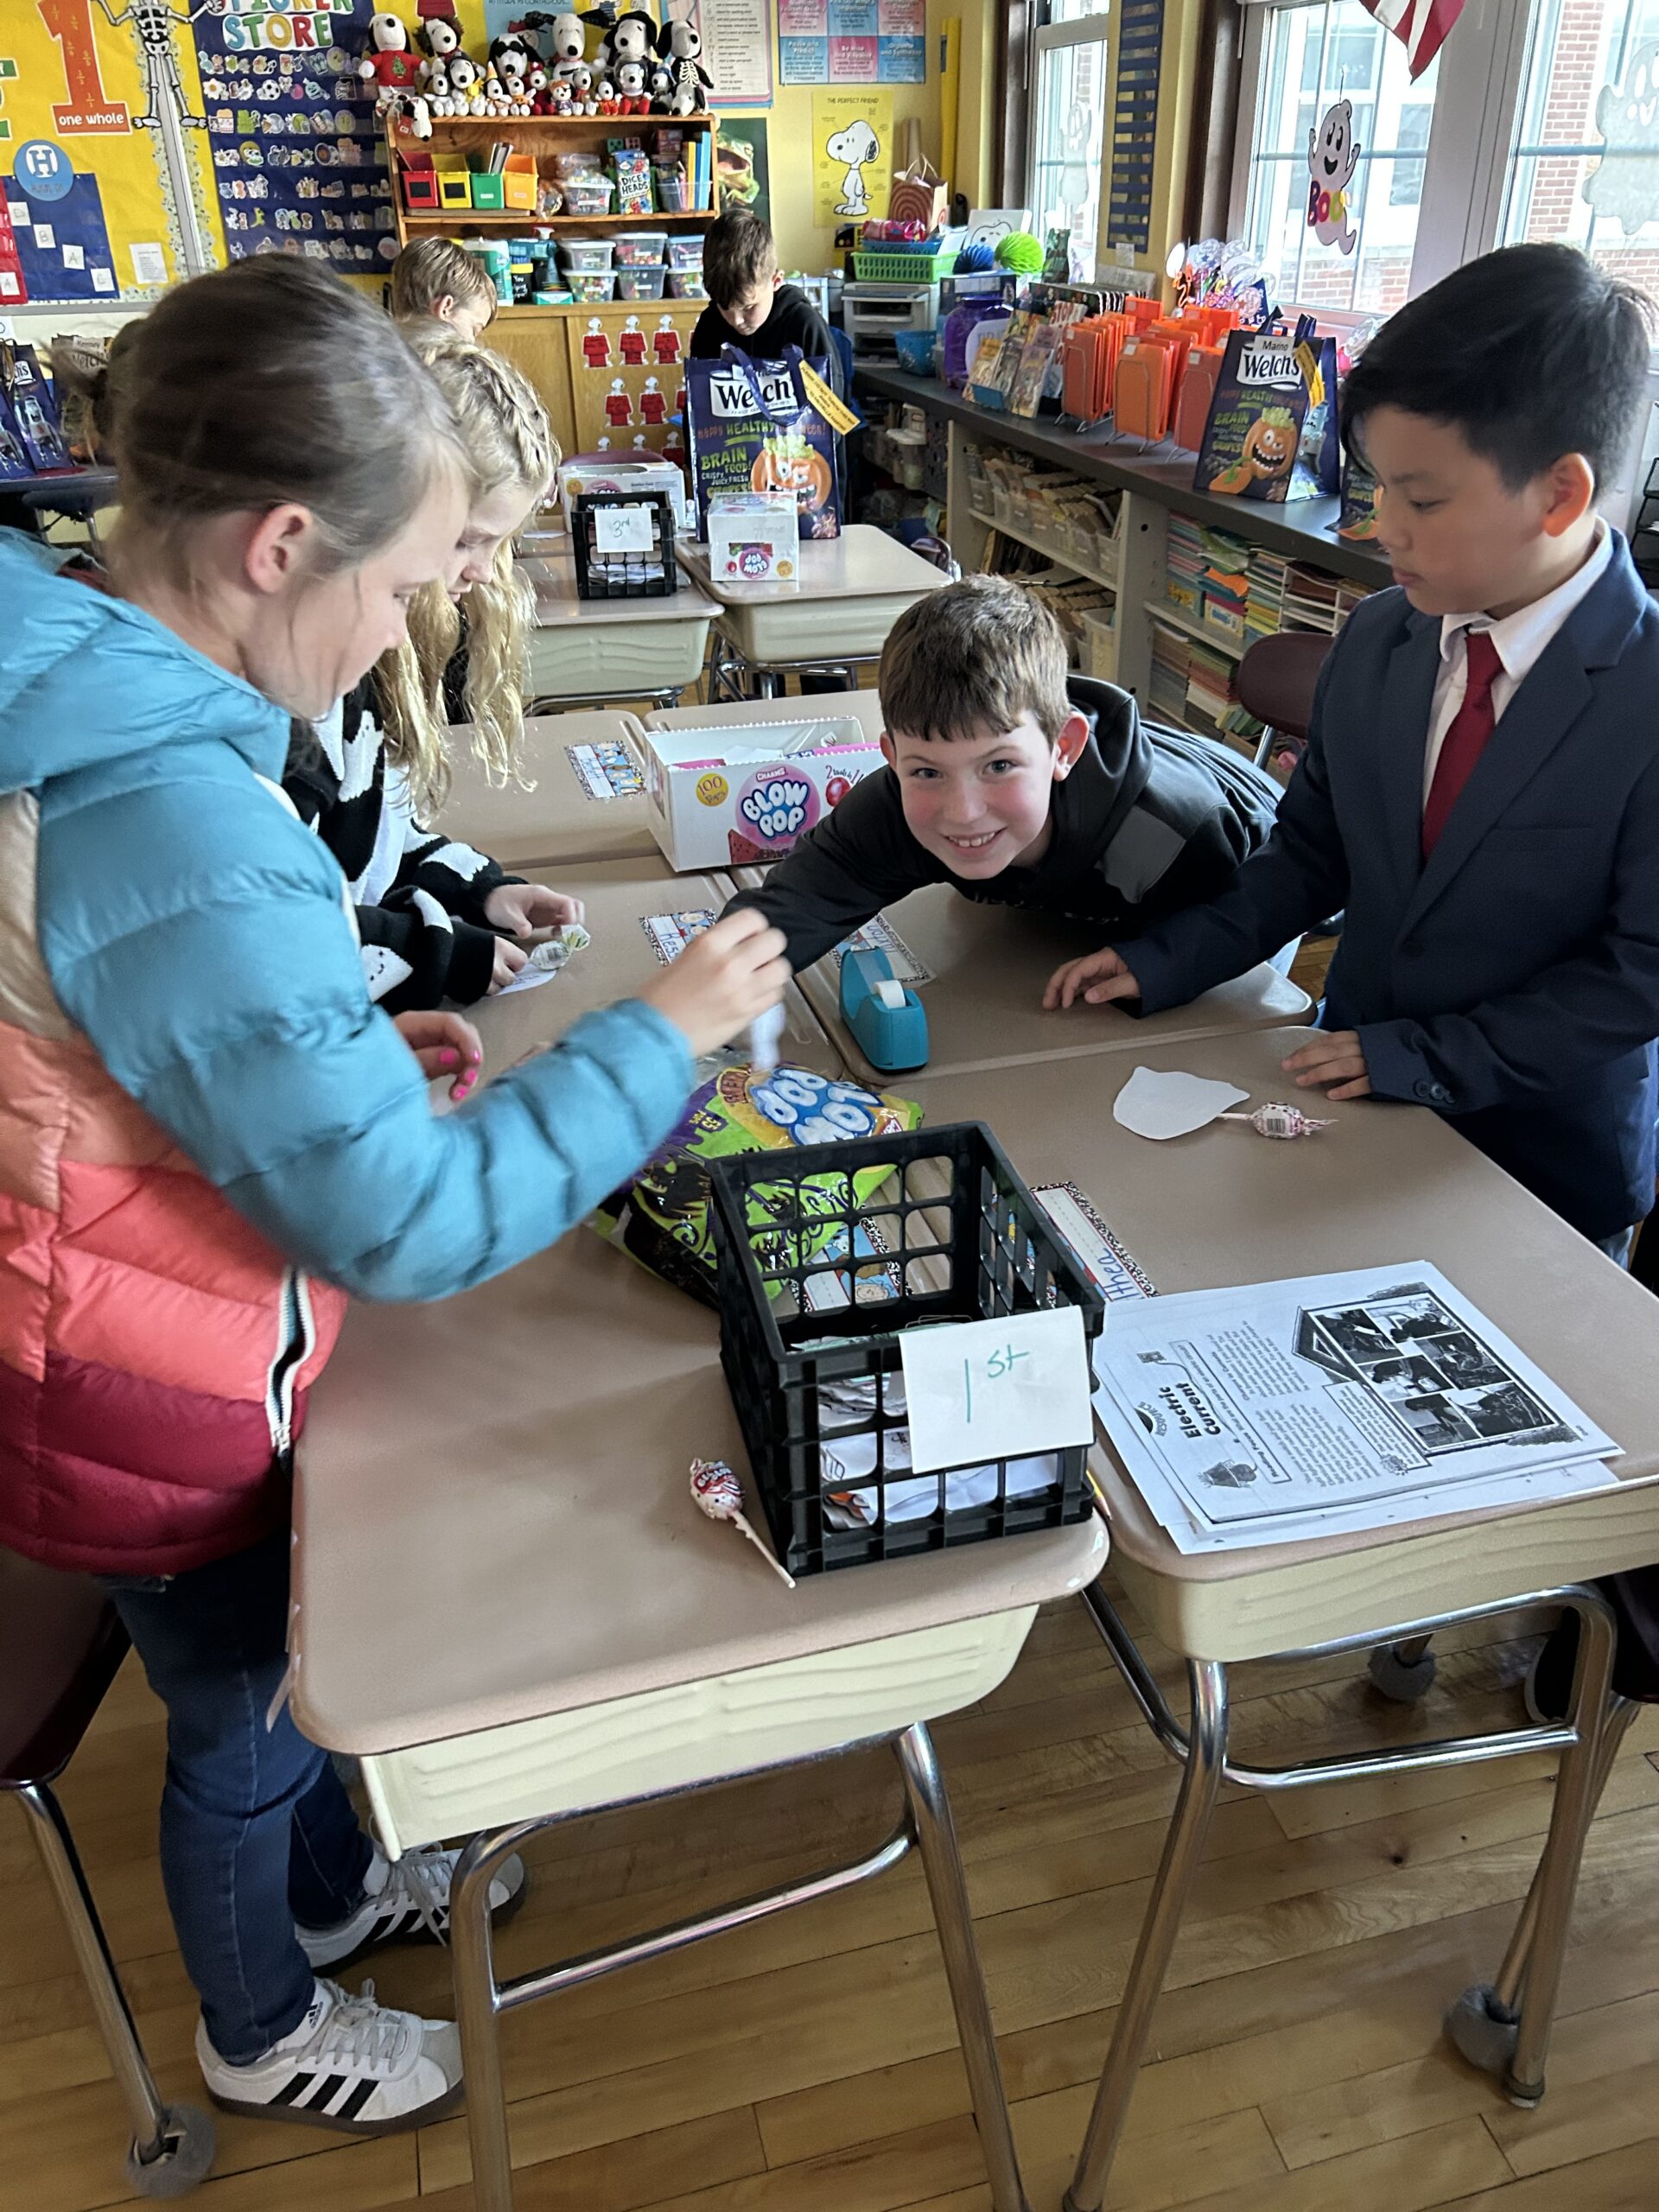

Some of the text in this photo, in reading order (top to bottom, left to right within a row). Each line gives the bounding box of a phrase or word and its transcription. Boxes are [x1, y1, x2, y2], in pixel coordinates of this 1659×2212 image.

[225, 14, 332, 49] STORE
[59, 113, 124, 126] one whole
[621, 175, 643, 186] DICE
[622, 181, 648, 195] HEADS
[1243, 353, 1300, 378] Welch's
[726, 420, 775, 435] HEALTHY
[701, 447, 747, 470] BRAIN
[724, 460, 752, 474] FOOD!
[613, 518, 630, 538] 3rd
[696, 775, 722, 796] 100
[757, 767, 785, 782] CHARMS
[741, 779, 809, 822] BLOW
[759, 805, 805, 839] POP
[756, 1069, 828, 1123] POP
[703, 1116, 722, 1130] 55
[963, 1344, 1030, 1424] 1st
[1159, 1387, 1203, 1439] Electric
[1176, 1382, 1221, 1434] Current
[1242, 1431, 1260, 1450] Focus
[1255, 1451, 1279, 1478] Reading
